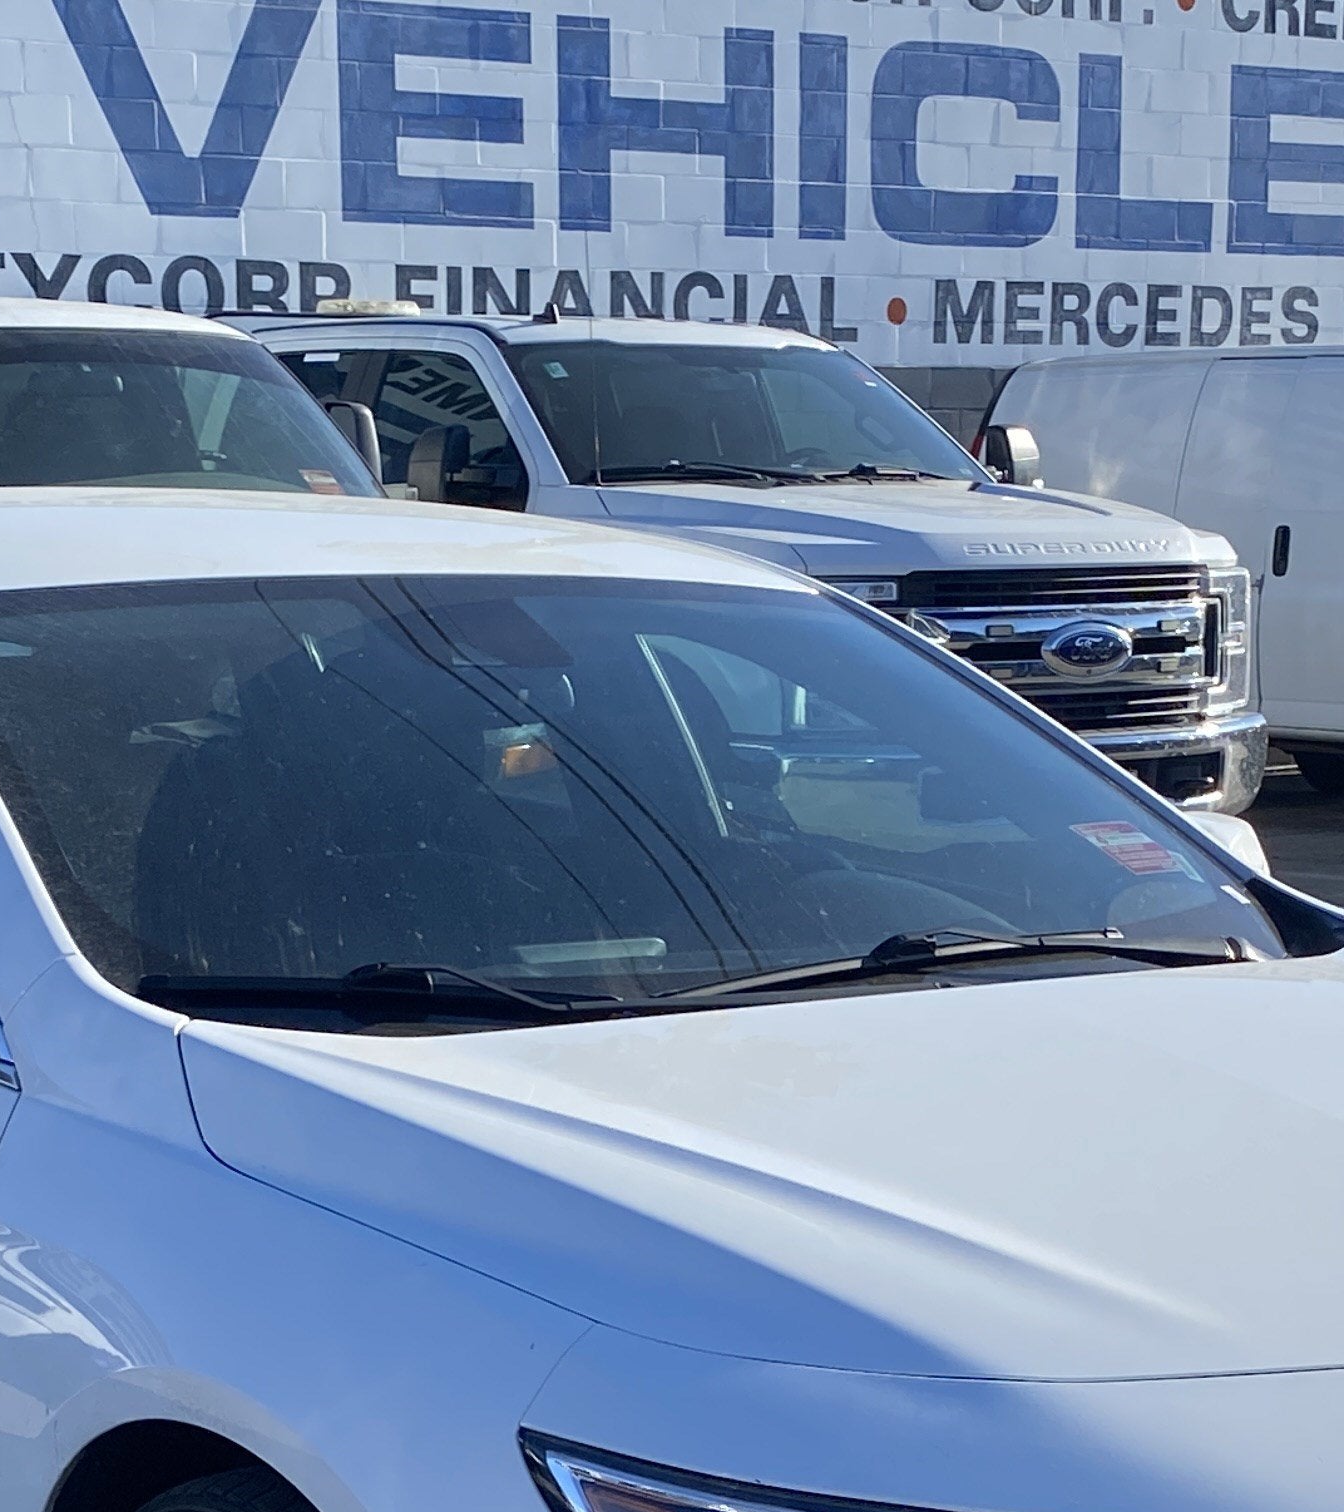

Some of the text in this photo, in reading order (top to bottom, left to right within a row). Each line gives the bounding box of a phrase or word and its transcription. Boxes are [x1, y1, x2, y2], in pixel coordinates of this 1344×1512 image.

[395, 264, 858, 342] FINANCIAL
[932, 278, 1319, 347] MERCEDES
[962, 538, 1170, 556] SUPER DUTY
